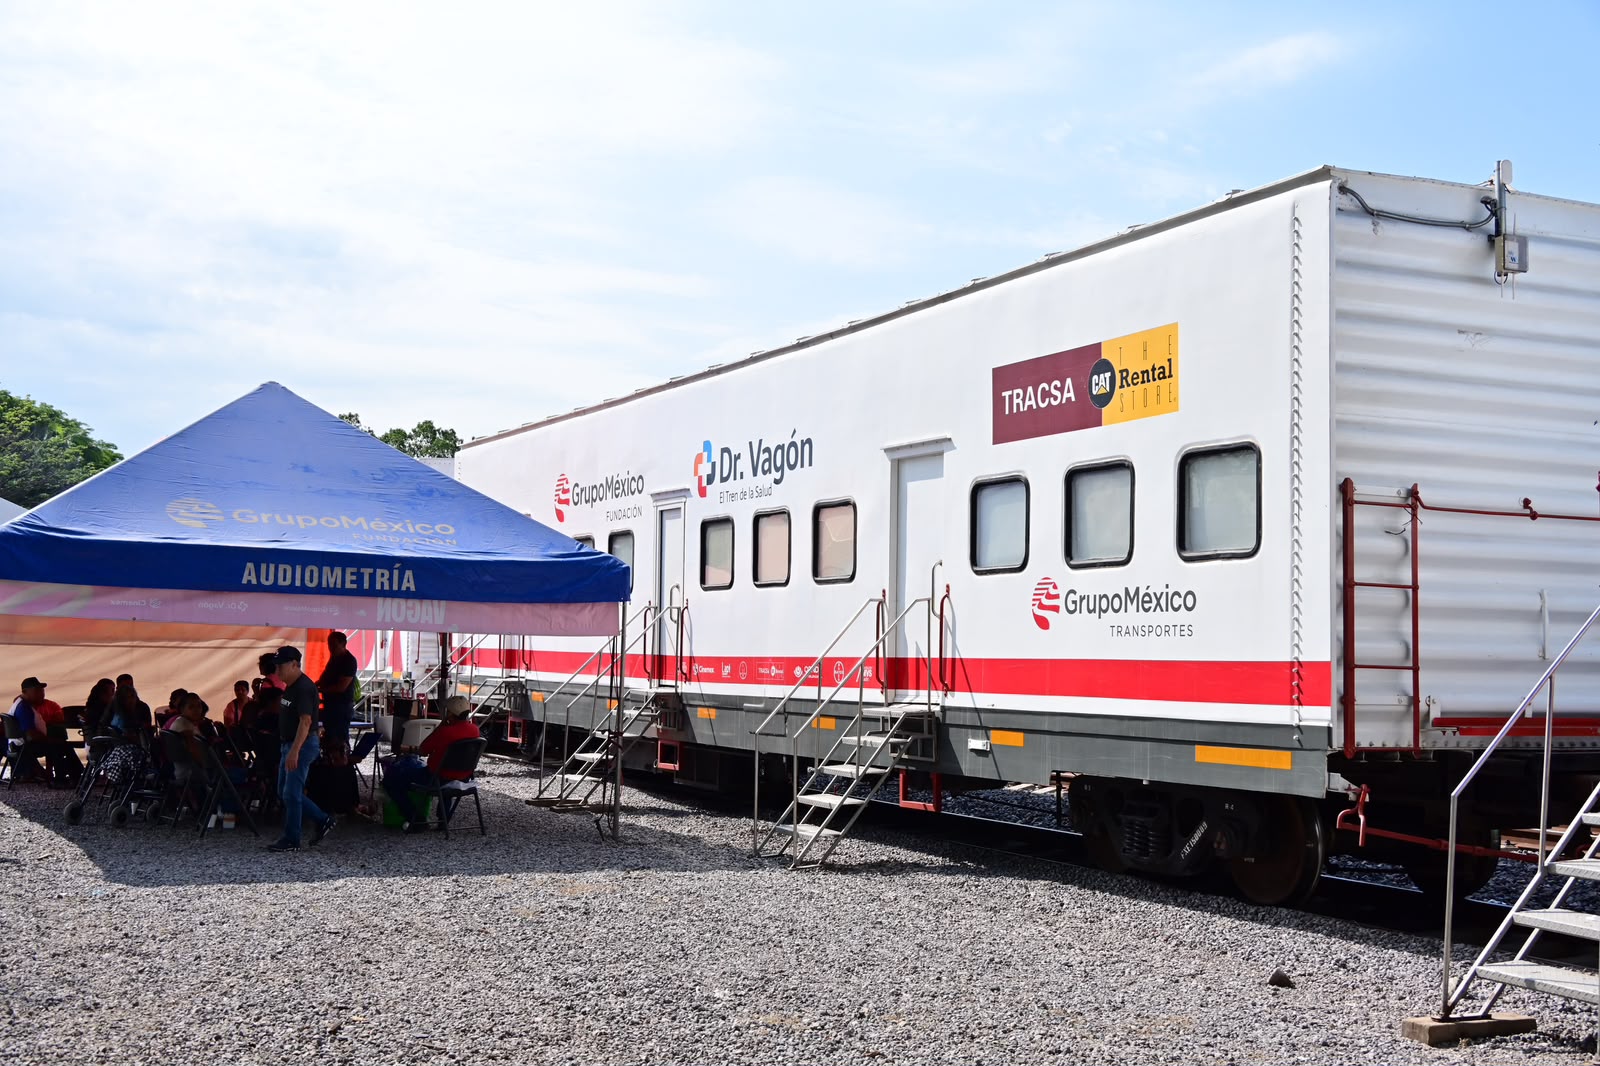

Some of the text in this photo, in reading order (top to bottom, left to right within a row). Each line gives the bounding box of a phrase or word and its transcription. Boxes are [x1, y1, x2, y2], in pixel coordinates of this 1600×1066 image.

[1118, 334, 1172, 366] THE
[1091, 371, 1111, 395] CAT
[1118, 358, 1174, 389] Rental
[1001, 377, 1076, 415] TRACSA
[719, 428, 814, 485] Dr. Vagón
[571, 470, 645, 509] GrupoMéxico
[719, 484, 773, 504] El Tren de la Salud
[231, 508, 456, 535] GrupoMéxico
[606, 503, 643, 522] FUNDACIÓN
[352, 532, 457, 546] FUNDACIÓN
[241, 562, 417, 592] AUDIOMETRÍA
[1064, 583, 1197, 620] GrupoMéxico
[1109, 624, 1194, 637] TRANSPORTES
